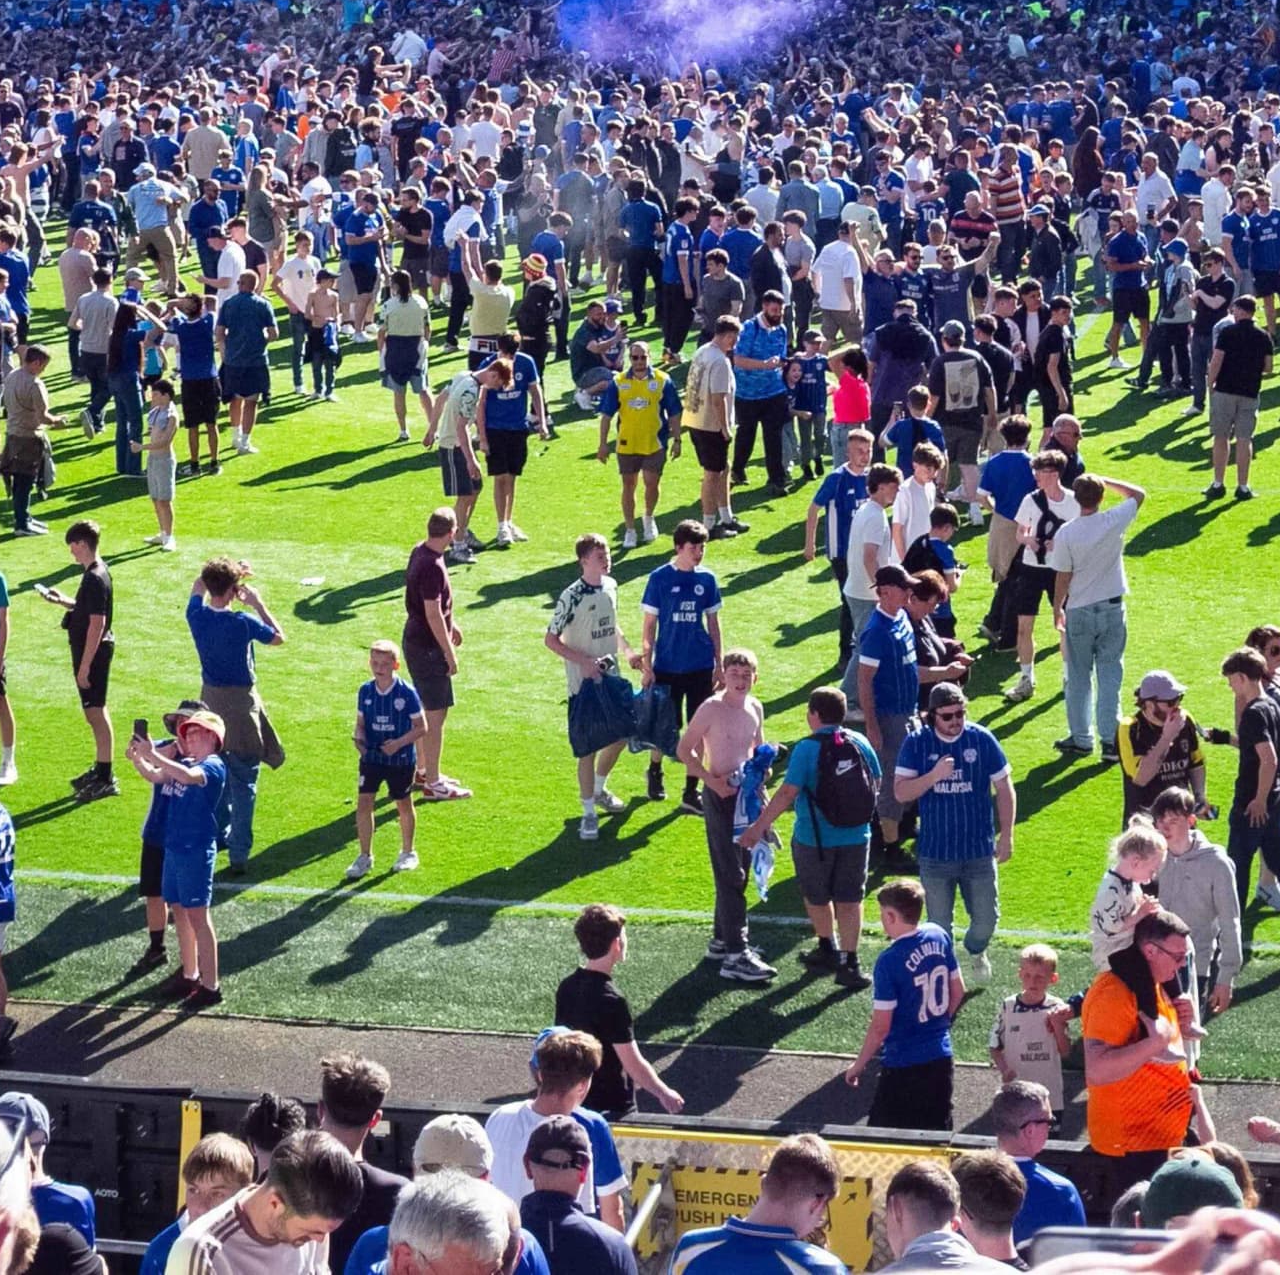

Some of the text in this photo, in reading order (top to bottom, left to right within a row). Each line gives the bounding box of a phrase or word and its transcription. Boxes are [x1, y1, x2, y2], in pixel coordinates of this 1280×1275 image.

[933, 781, 973, 794] MALAYSIA
[913, 965, 950, 1023] 10
[94, 1188, 119, 1198] AOTO
[674, 1189, 760, 1208] EMERGEN
[675, 1208, 715, 1225] USH
